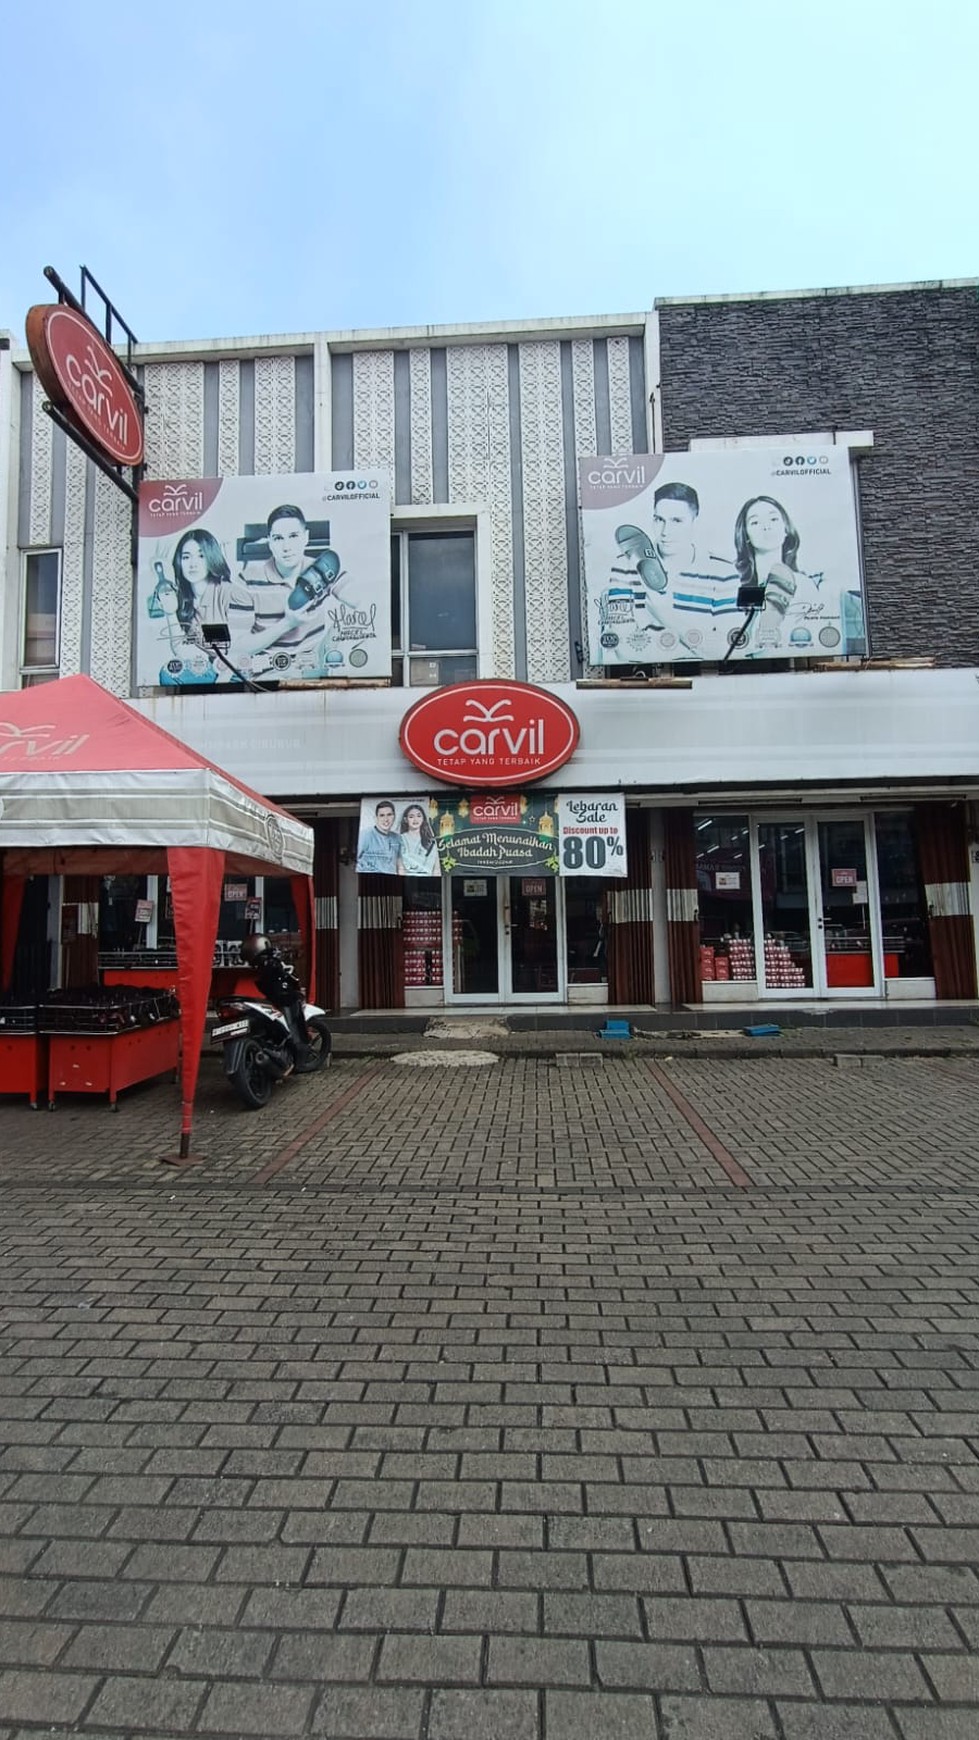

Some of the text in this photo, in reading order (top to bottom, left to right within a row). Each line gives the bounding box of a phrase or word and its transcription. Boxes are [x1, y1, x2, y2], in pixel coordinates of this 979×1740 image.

[66, 354, 128, 445] carvil
[588, 466, 645, 484] carvil
[148, 492, 203, 512] carvil
[434, 719, 544, 756] carvil
[437, 757, 541, 766] TETAP YANG TERBAIK
[473, 803, 518, 816] carvil
[566, 800, 618, 814] Lebaran
[576, 810, 607, 823] Sale
[563, 826, 619, 835] Discount up to
[437, 832, 553, 851] Selamat Menunaikan
[457, 845, 534, 859] Ibadah Puasa
[563, 835, 624, 869] 80%
